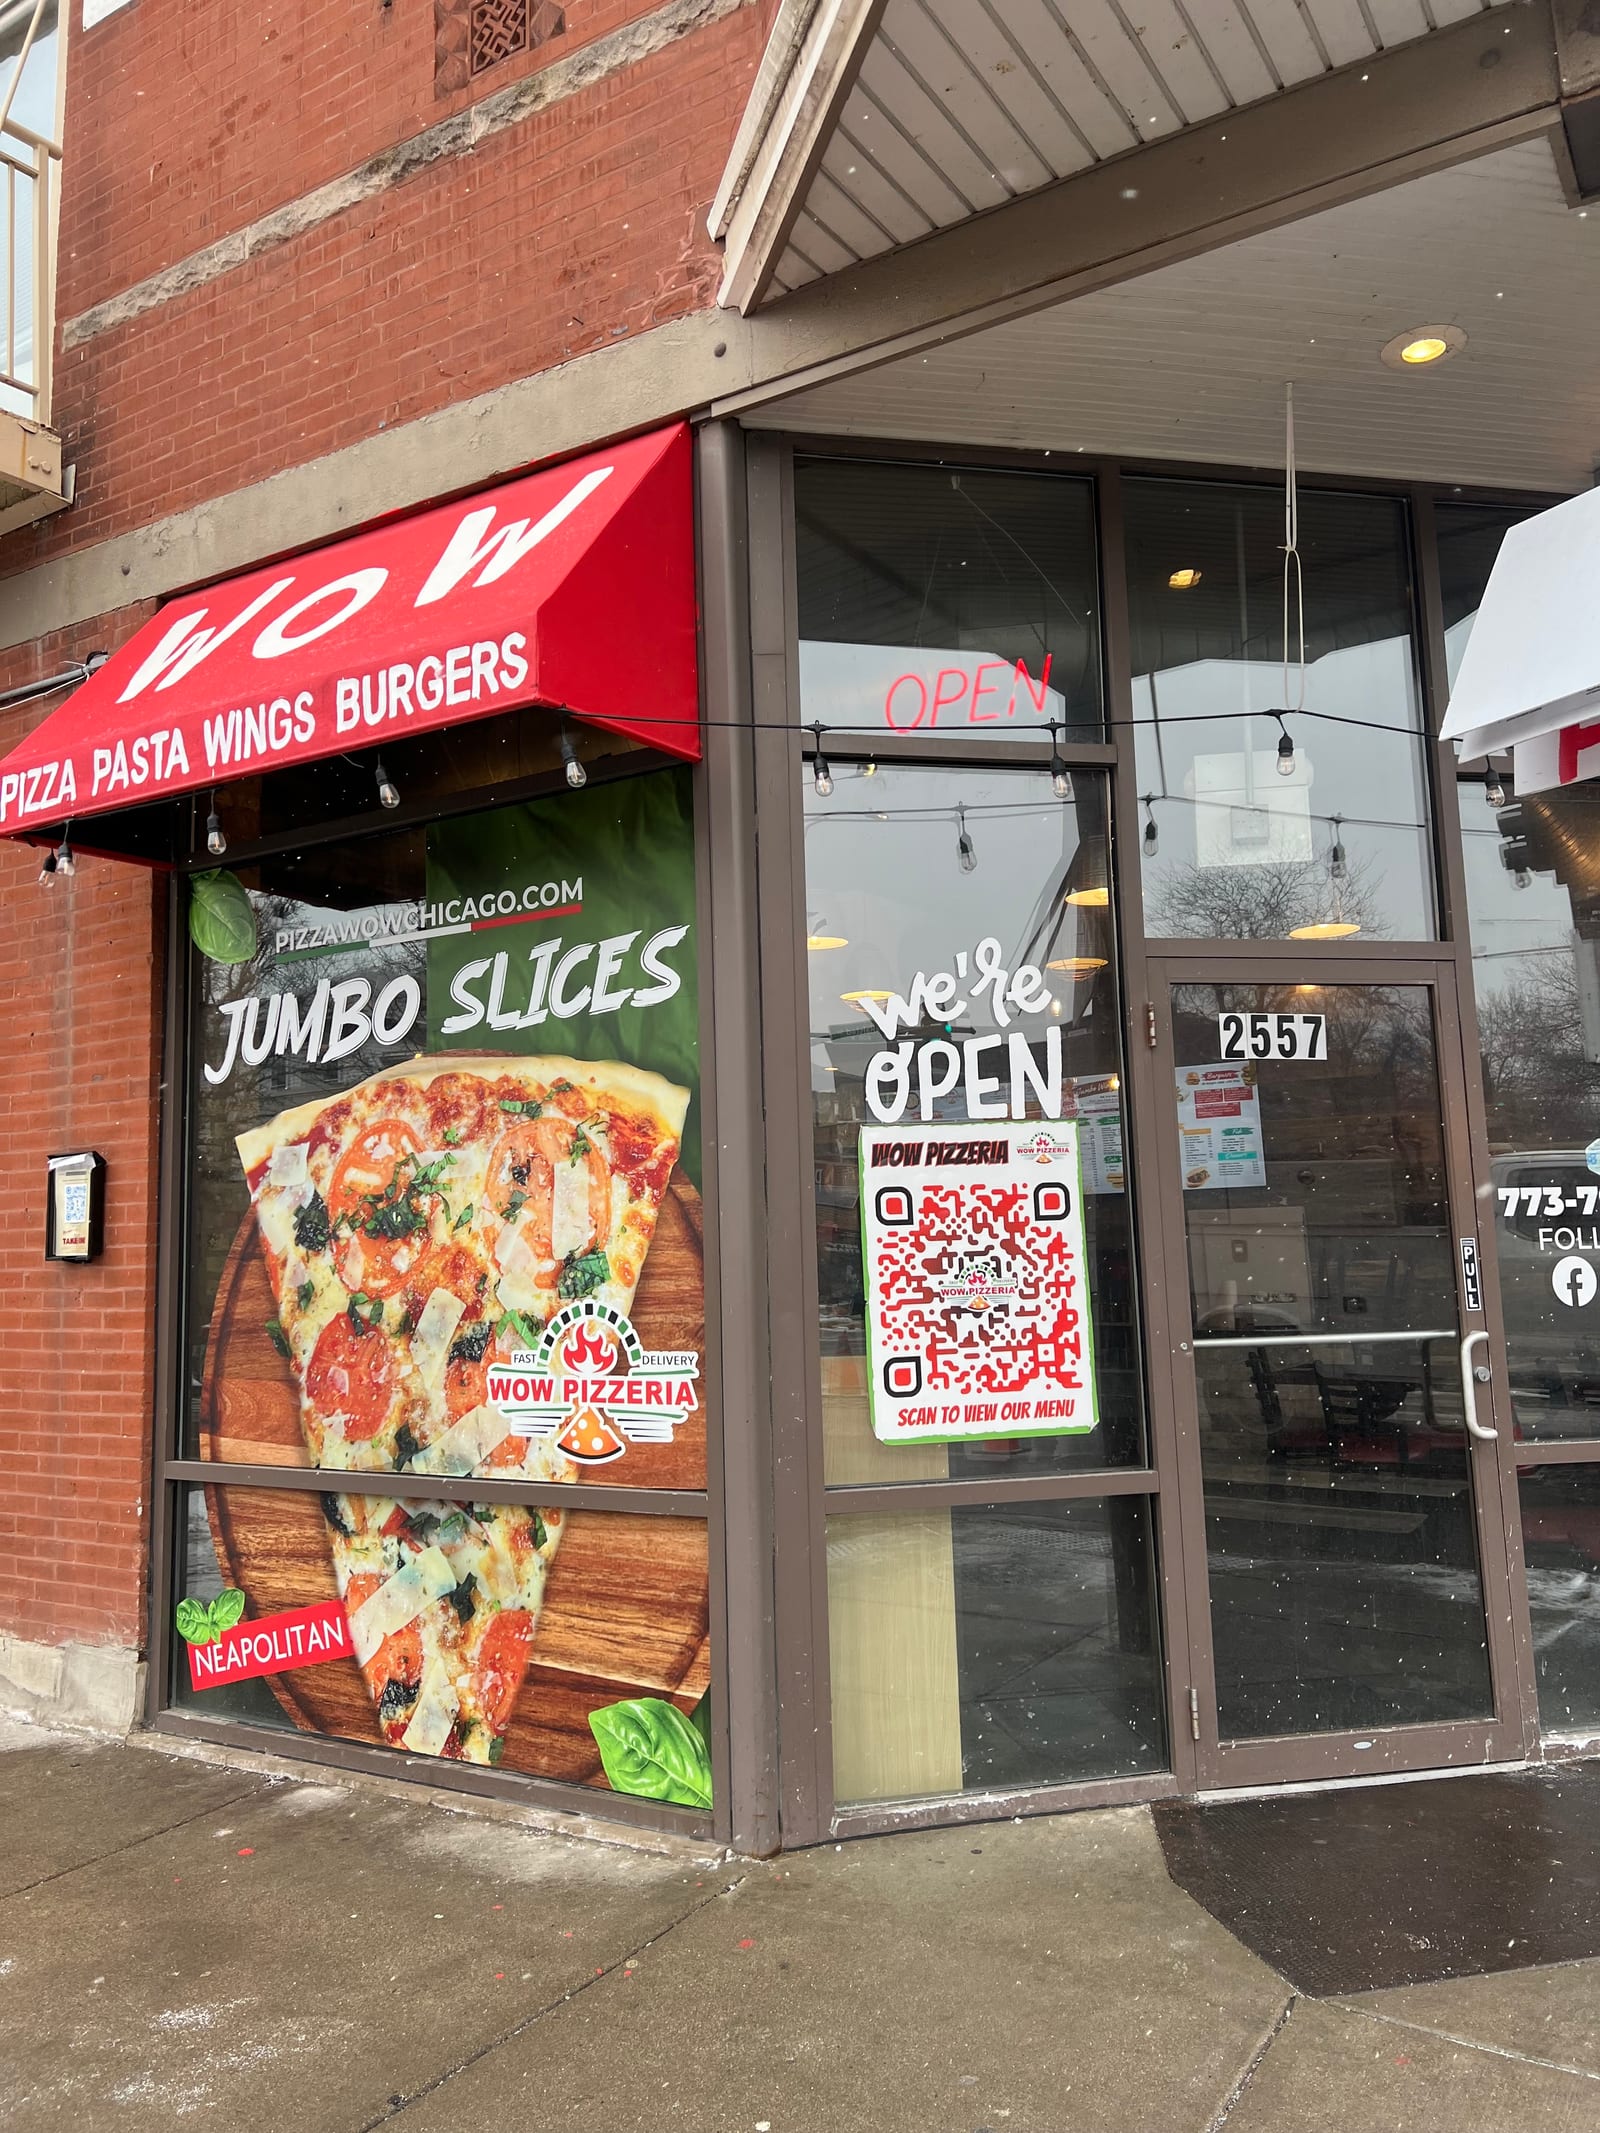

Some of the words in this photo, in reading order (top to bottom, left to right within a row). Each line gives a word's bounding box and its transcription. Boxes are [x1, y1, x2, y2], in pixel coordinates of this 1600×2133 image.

[116, 466, 614, 704] WOW
[885, 653, 1053, 734] OPEN
[0, 759, 76, 823] PIZZA
[91, 729, 189, 797] PASTA
[203, 690, 316, 767] WINGS
[335, 631, 529, 735] BURGERS
[275, 876, 584, 955] PIZZAWOWCHICAGO.COM
[203, 974, 421, 1085] JUMBO
[440, 924, 690, 1034] SLICES
[1222, 1014, 1322, 1058] 2557
[865, 1025, 1062, 1122] OPEN
[871, 1141, 924, 1167] WOW
[925, 1140, 1009, 1167] PIZZERIA
[1498, 1186, 1600, 1217] 773-7
[941, 1288, 966, 1297] WOW
[968, 1286, 1016, 1296] PIZZERIA
[1464, 1247, 1479, 1308] PULL
[513, 1354, 537, 1364] FAST
[642, 1355, 695, 1366] DELIVERY
[489, 1378, 554, 1401] WOW
[563, 1379, 695, 1406] PIZZERIA
[897, 1407, 938, 1427] SCAN
[940, 1405, 961, 1424] TO
[963, 1402, 998, 1423] VIEW
[1000, 1401, 1031, 1420] OUR
[1033, 1398, 1075, 1419] MENU
[195, 1616, 344, 1677] NEAPOLITAN
